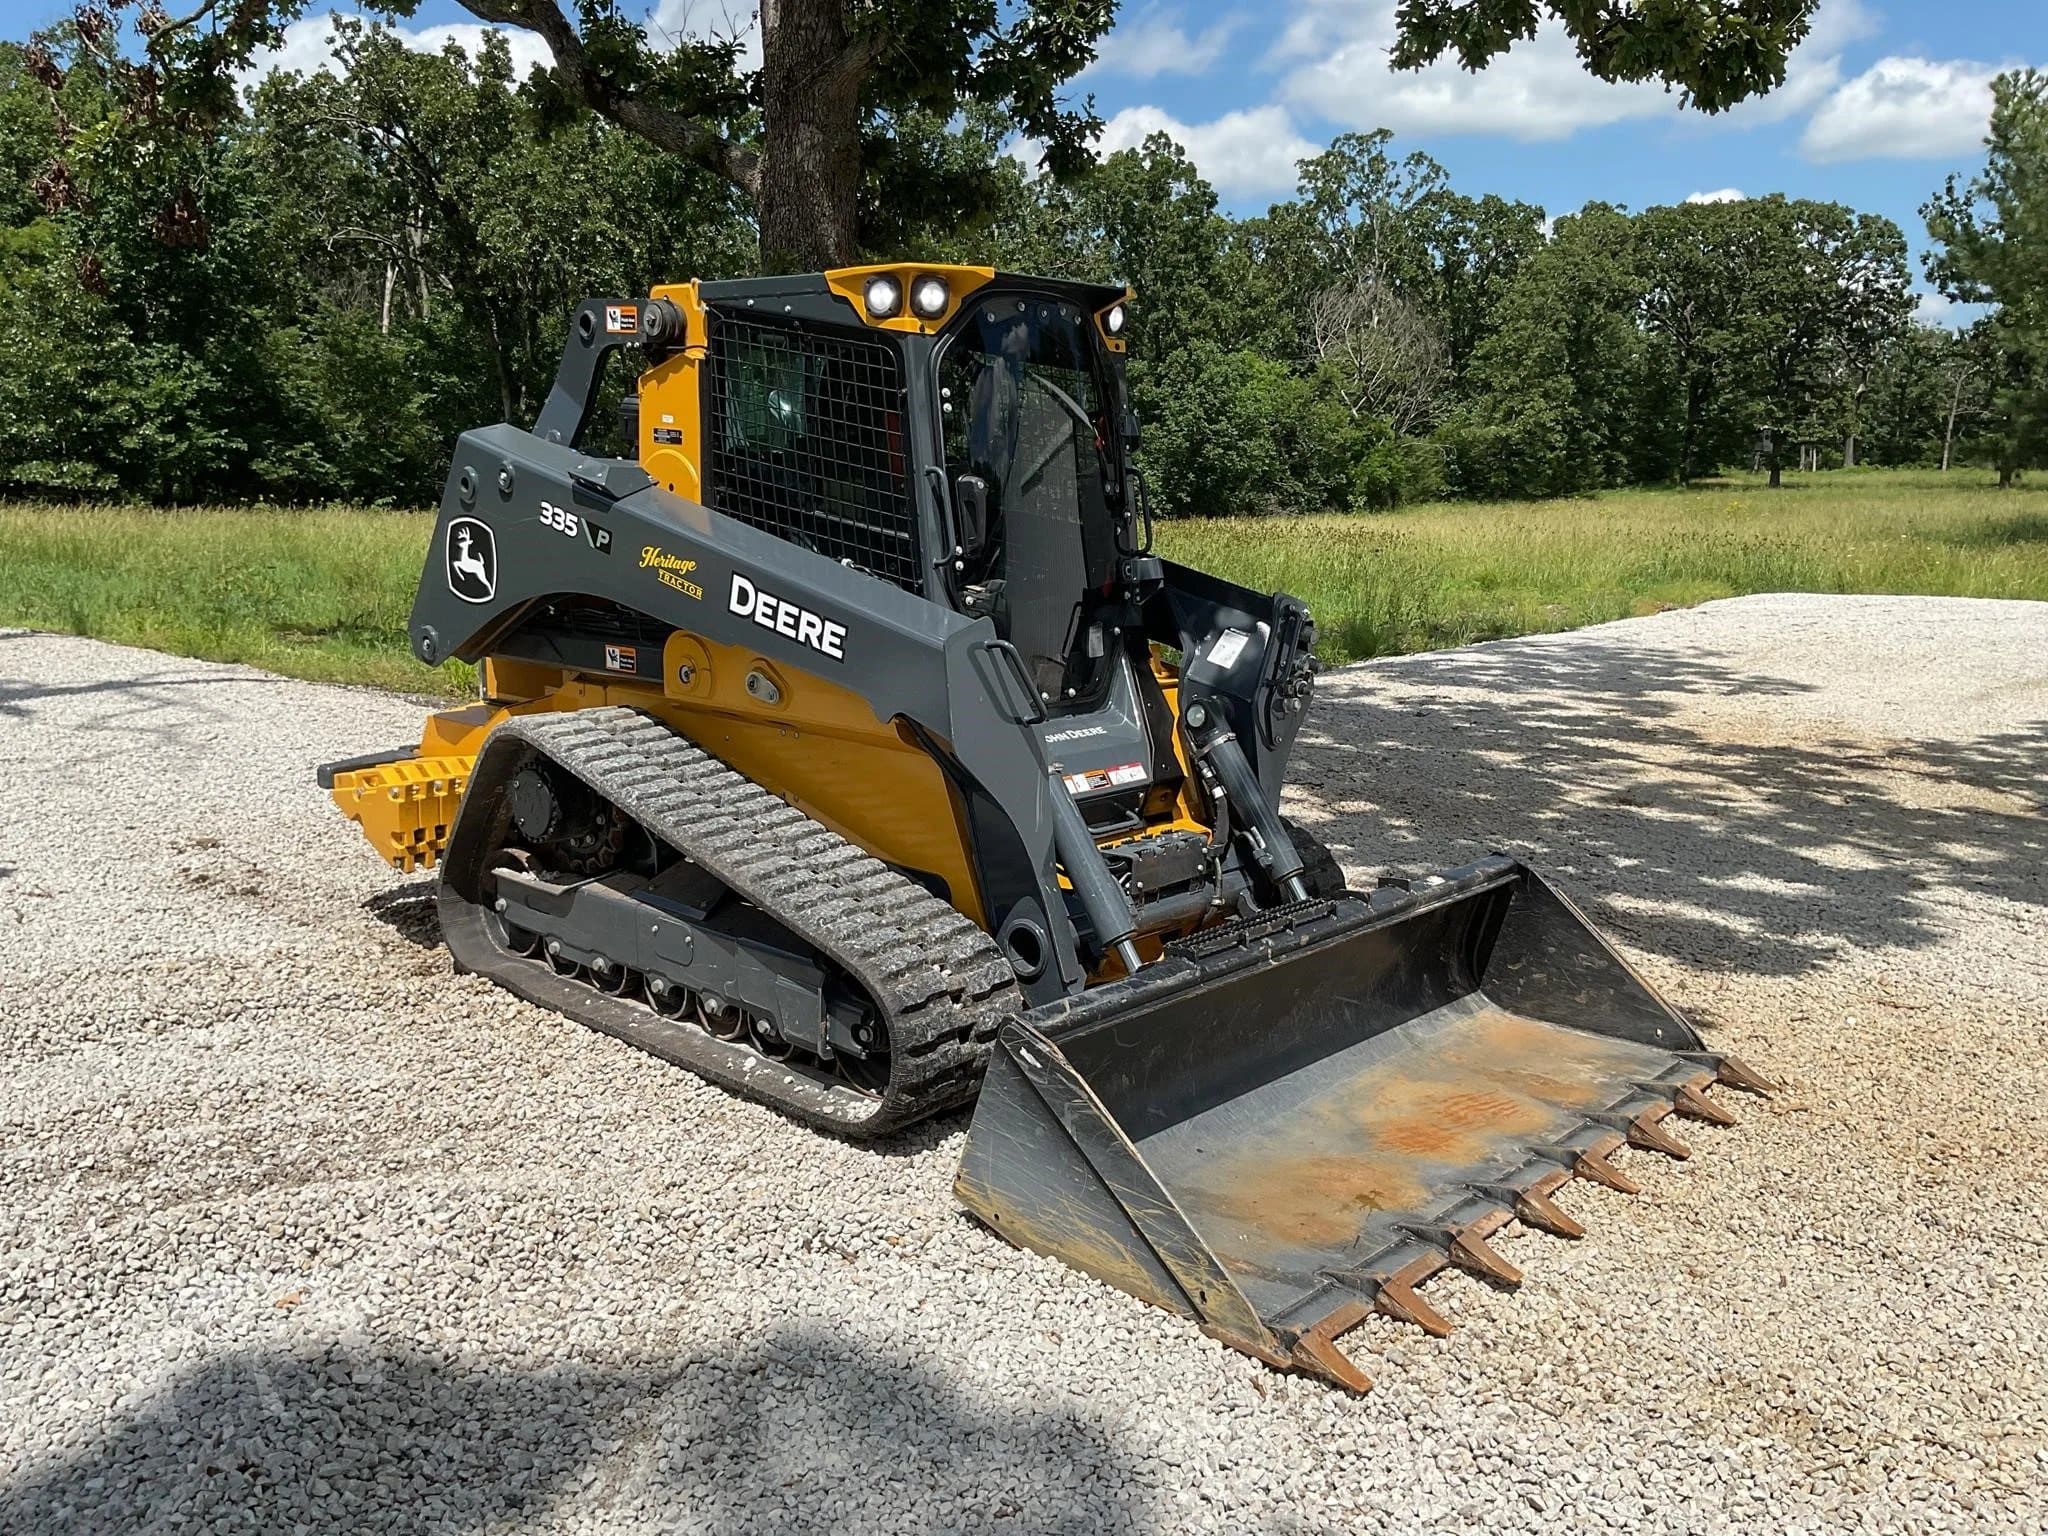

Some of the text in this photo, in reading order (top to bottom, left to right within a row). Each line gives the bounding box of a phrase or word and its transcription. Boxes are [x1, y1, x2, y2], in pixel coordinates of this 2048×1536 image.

[539, 501, 610, 548] 335 P
[639, 546, 697, 575] Heritage
[658, 570, 703, 599] TRACTOR
[729, 574, 847, 660] DEERE
[1044, 726, 1108, 744] OHN DEERE
